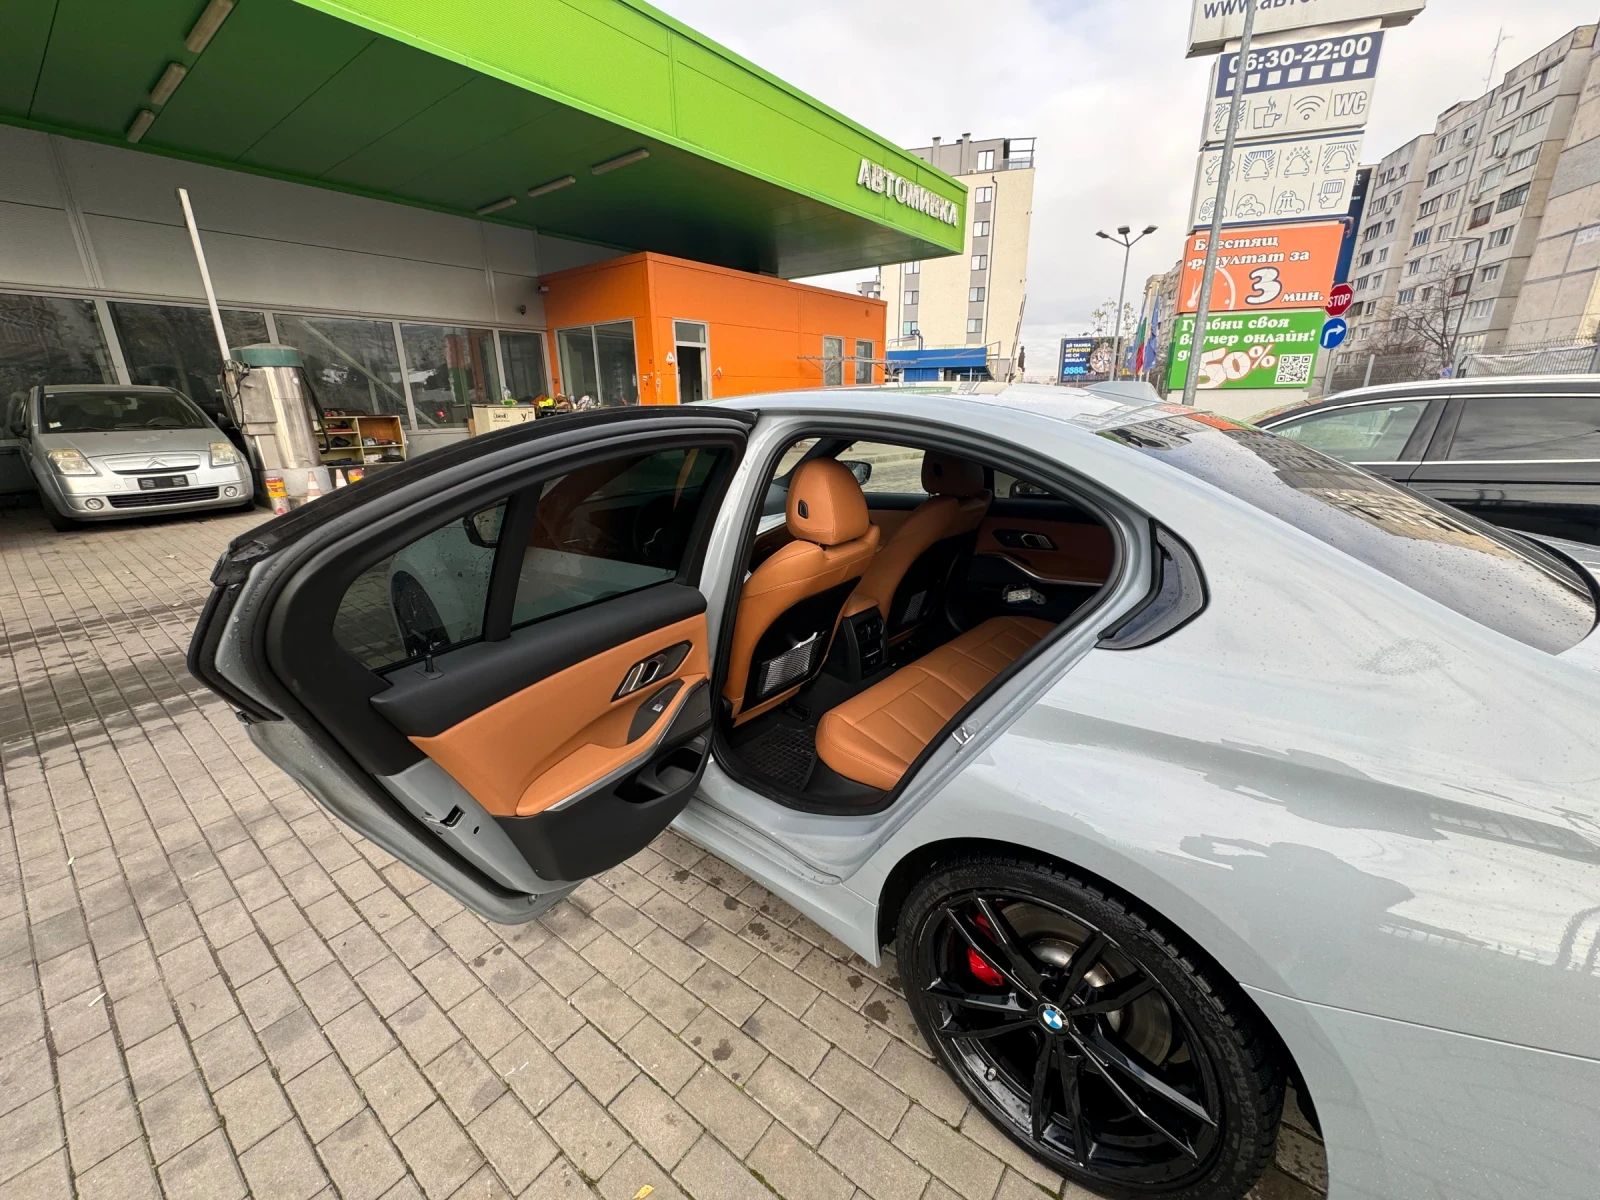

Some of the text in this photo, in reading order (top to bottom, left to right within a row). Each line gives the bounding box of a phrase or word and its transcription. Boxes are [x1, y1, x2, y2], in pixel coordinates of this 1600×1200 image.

[1228, 36, 1373, 74] 06:30-22:00
[1333, 91, 1367, 117] WC
[857, 158, 959, 228] АВТОМИВКА
[1193, 236, 1279, 251] Бестящ
[1289, 251, 1310, 262] за
[1245, 266, 1325, 305] 3 мин.
[1327, 293, 1351, 308] STOP
[1248, 316, 1290, 329] своя
[1243, 329, 1316, 344] онлайн!
[1196, 343, 1278, 389] 50%
